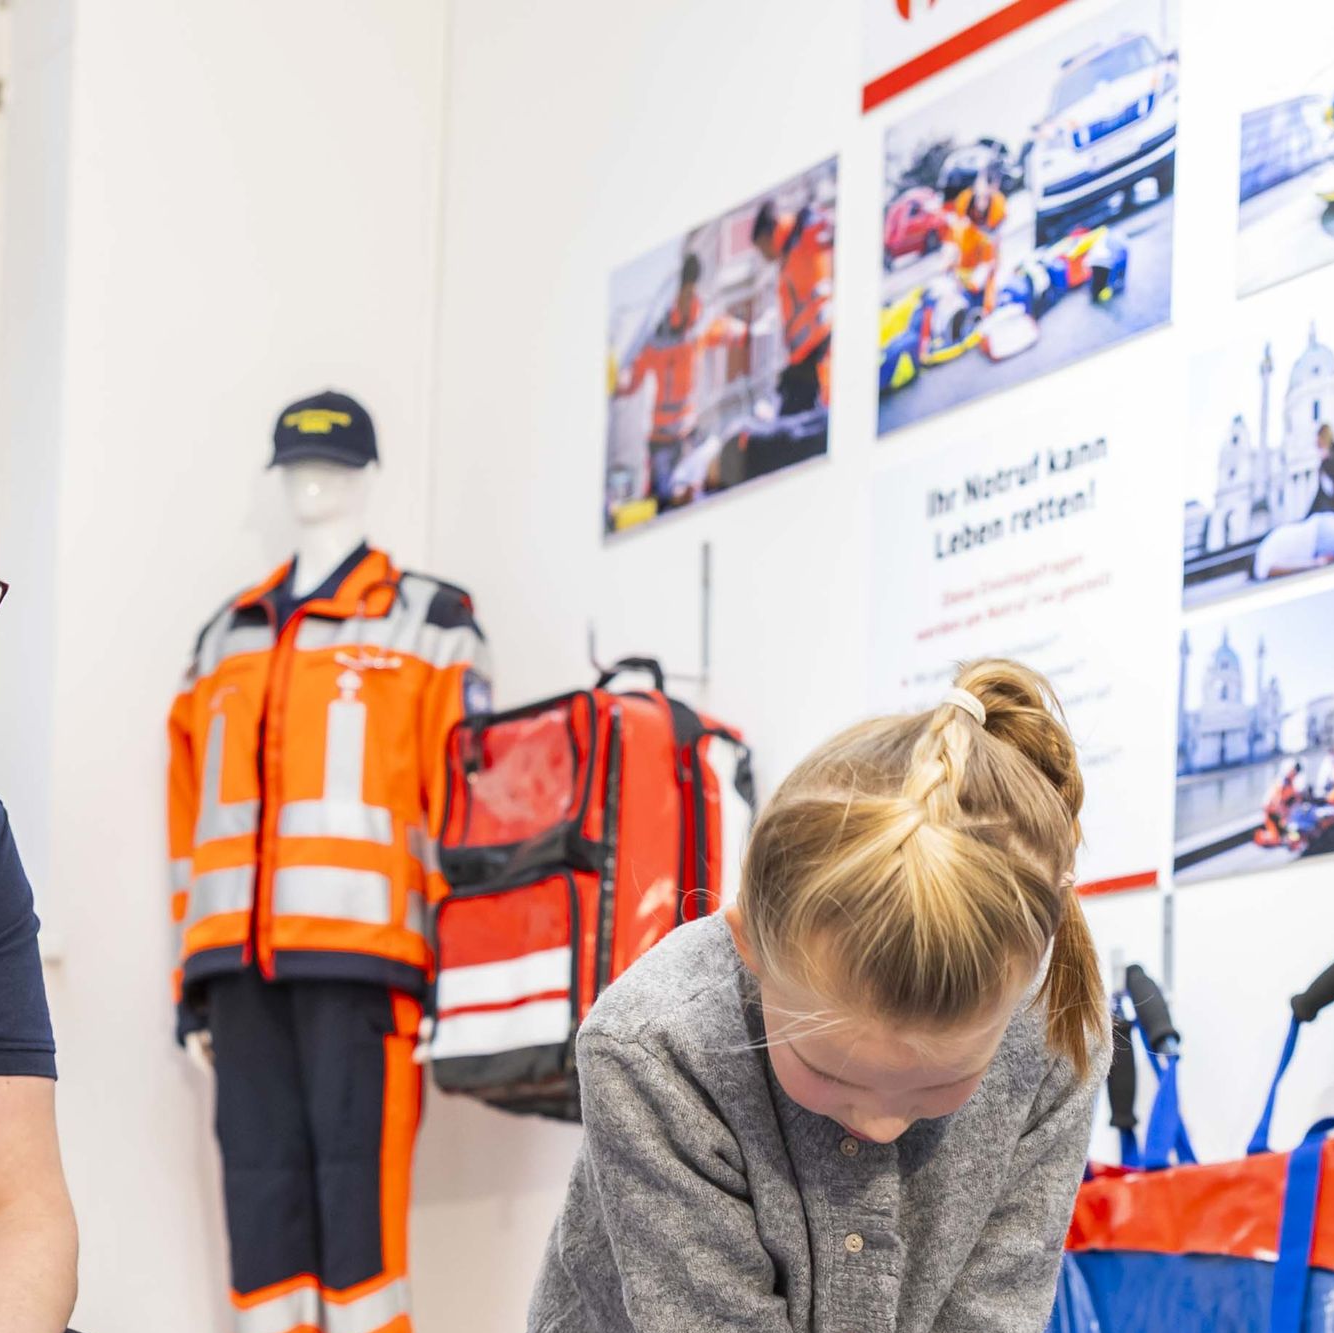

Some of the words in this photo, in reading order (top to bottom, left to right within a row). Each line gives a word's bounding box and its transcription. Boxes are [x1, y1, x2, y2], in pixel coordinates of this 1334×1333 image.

[926, 487, 957, 518] Ihr
[964, 453, 1041, 506] Notruf
[1047, 436, 1108, 475] kann
[934, 517, 1003, 561] Leben
[1010, 477, 1097, 533] retten!
